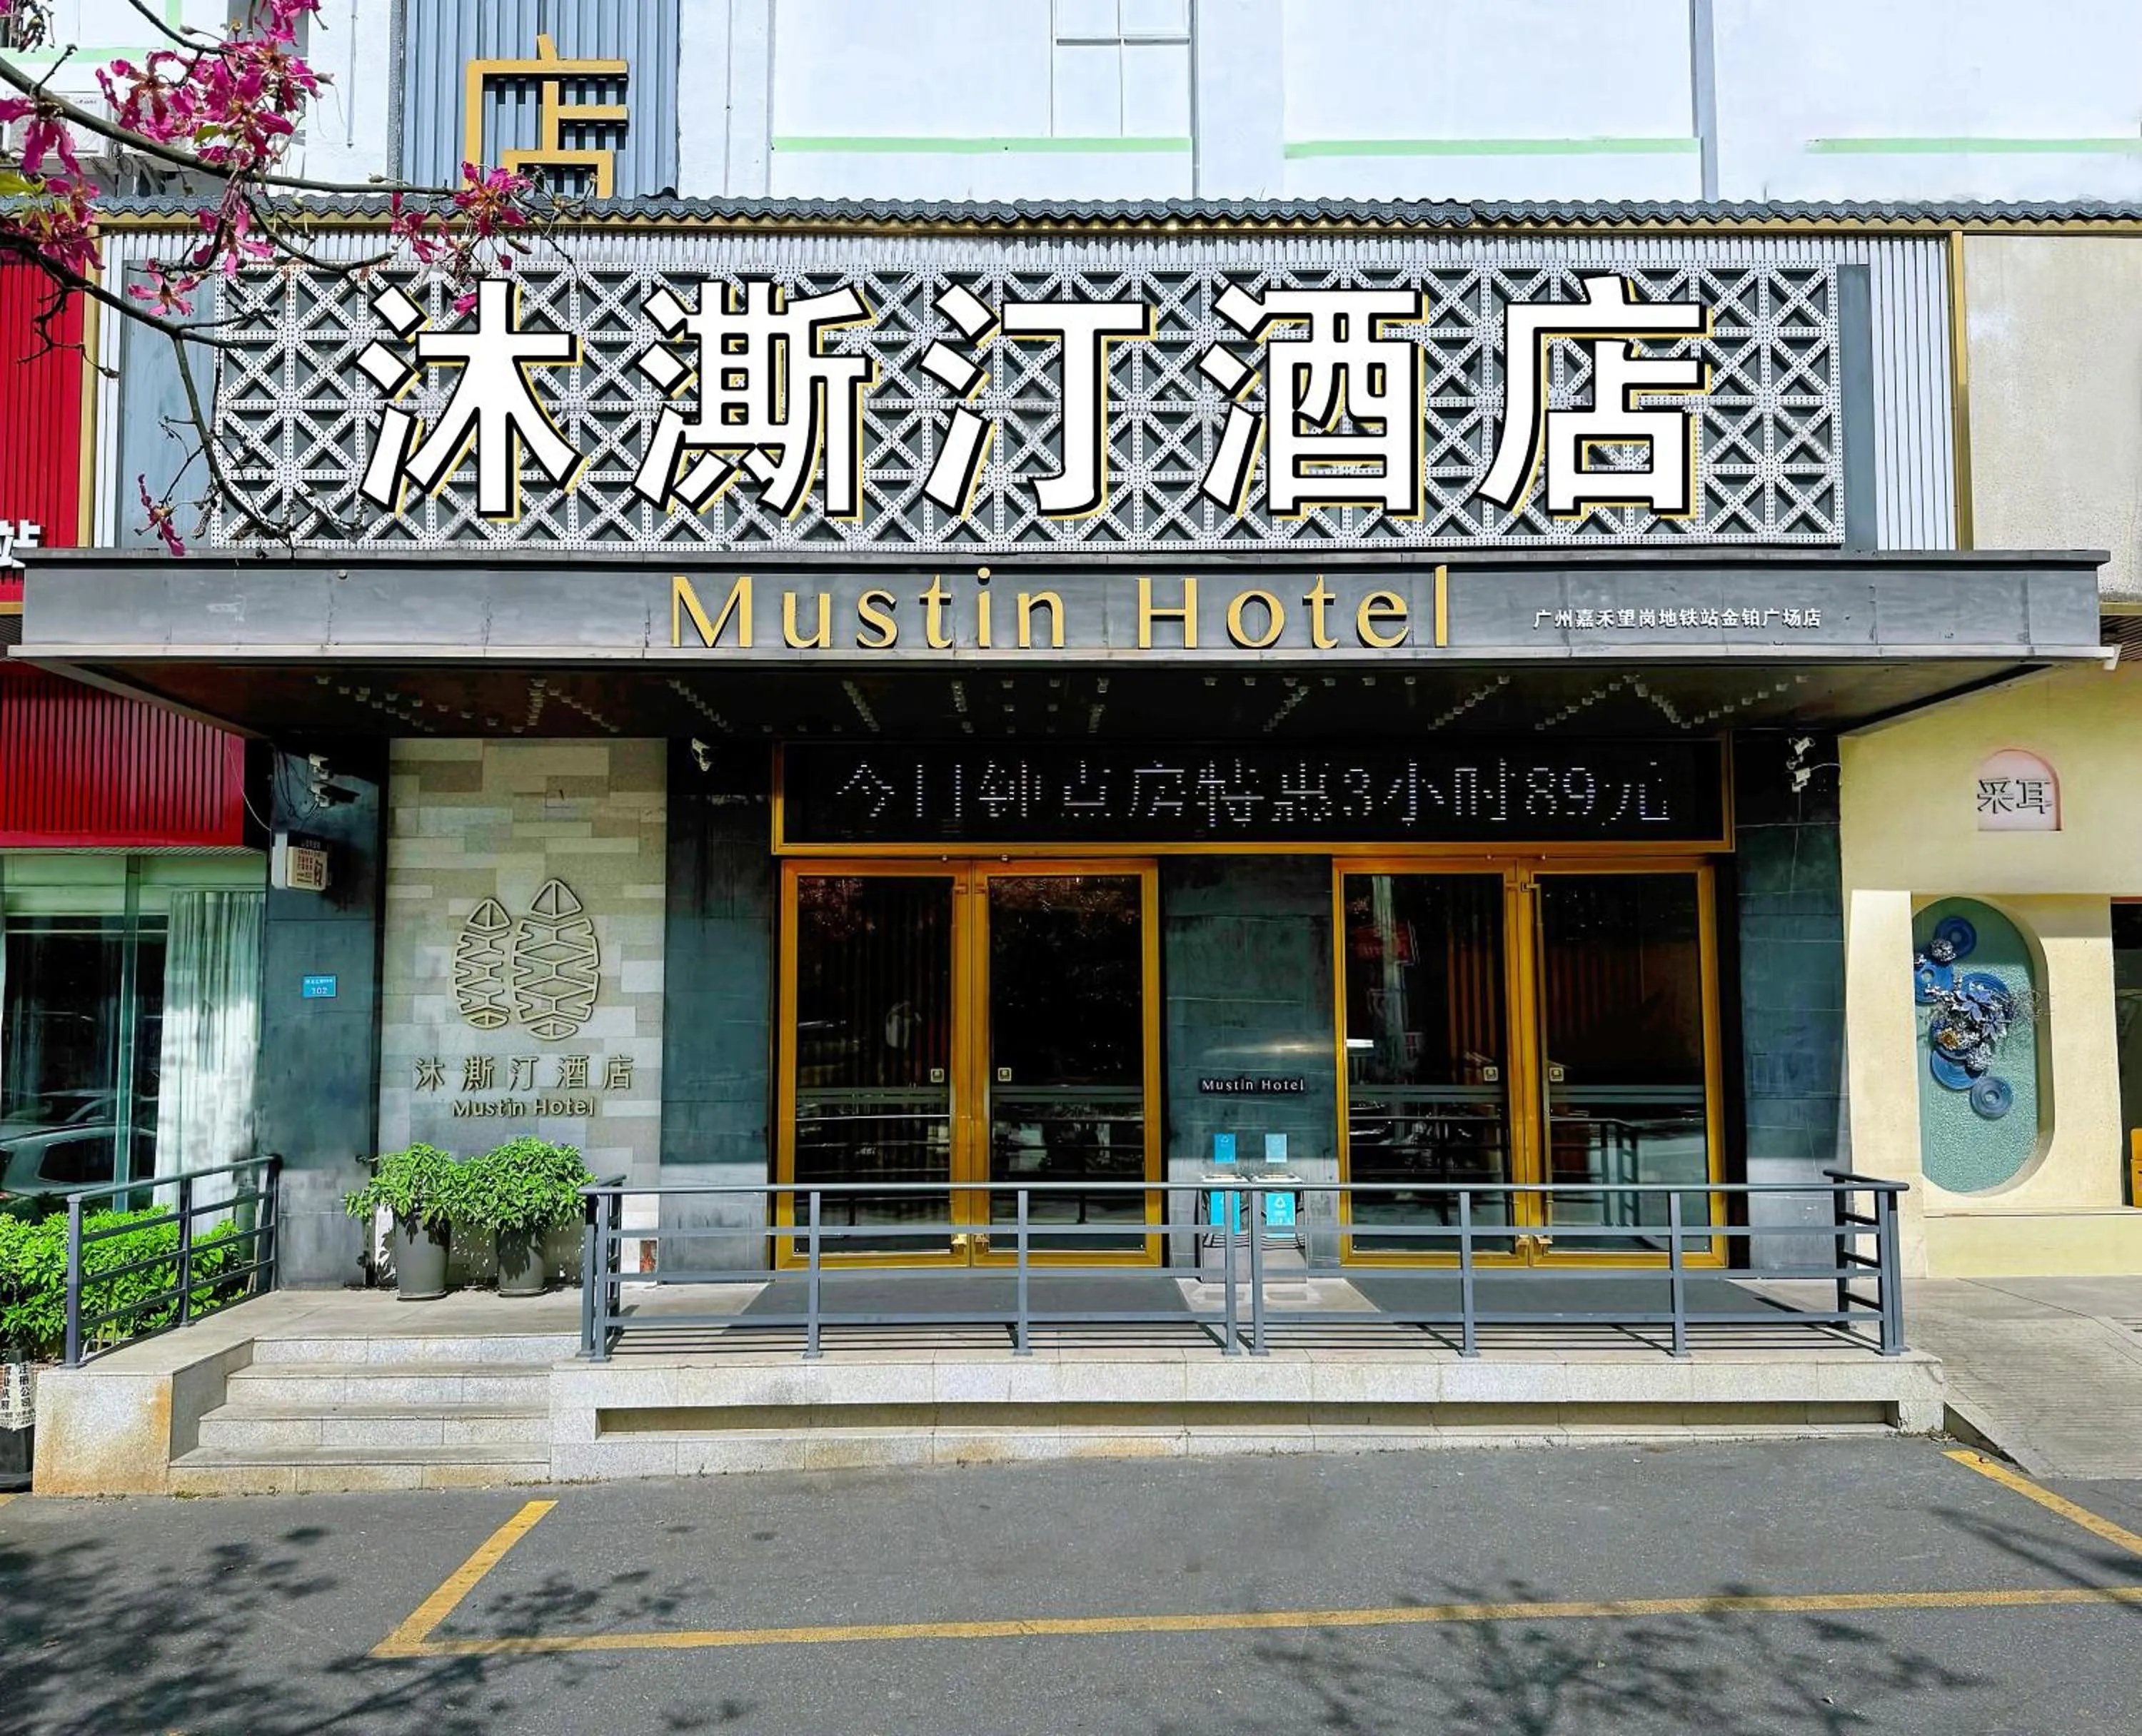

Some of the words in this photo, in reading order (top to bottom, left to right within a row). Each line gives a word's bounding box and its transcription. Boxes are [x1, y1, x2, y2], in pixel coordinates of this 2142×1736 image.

[461, 34, 628, 199] 店
[672, 570, 1065, 648] Mustin
[1138, 566, 1449, 648] Hotel
[1534, 608, 1821, 627] 广州嘉禾望岗地铁站金铂广场店
[1977, 777, 2053, 814] 采耳
[1202, 1079, 1253, 1091] Mustin
[1262, 1079, 1304, 1091] Hotel
[451, 1096, 525, 1117] Mustin
[533, 1096, 595, 1117] Hotel
